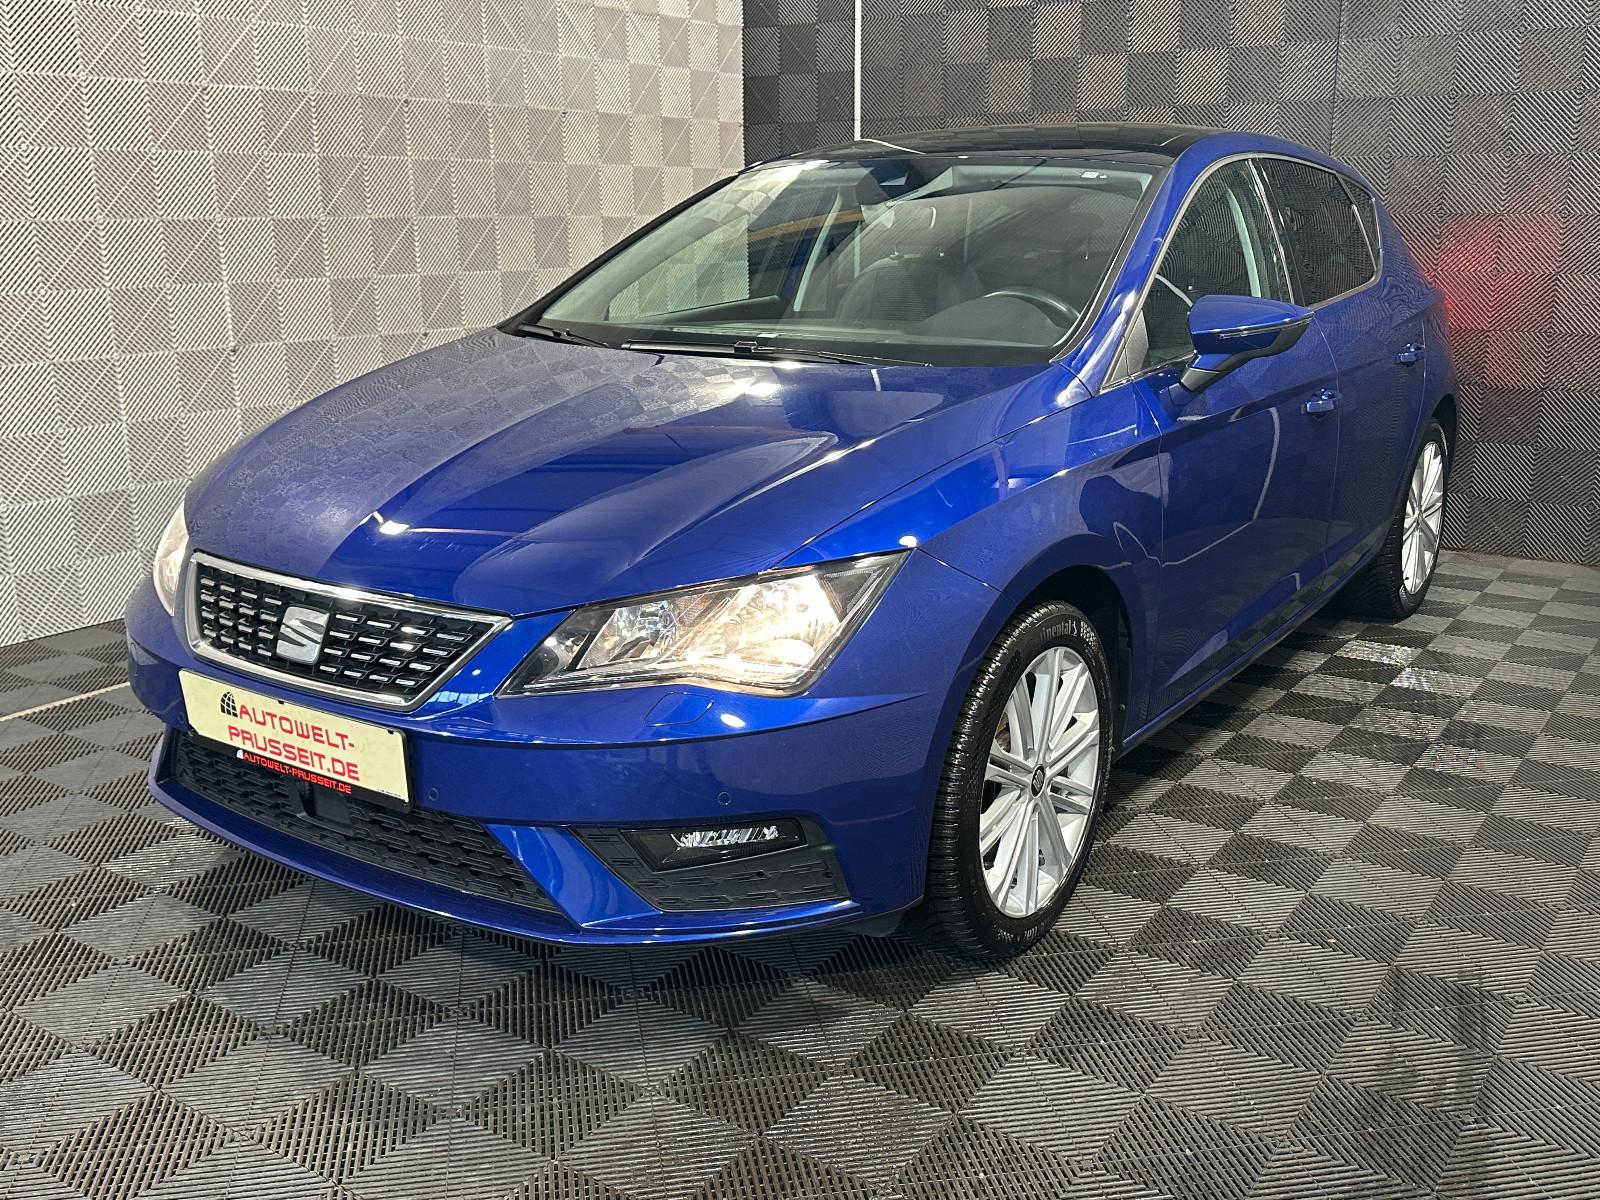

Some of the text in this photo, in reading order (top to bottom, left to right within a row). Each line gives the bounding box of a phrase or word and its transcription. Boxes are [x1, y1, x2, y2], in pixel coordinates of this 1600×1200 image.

[239, 704, 354, 750] AUTOWELT-
[227, 725, 360, 781] PRUSSEIT.DE
[243, 752, 352, 794] AUTOWELT-PRUSSEIT.DE
